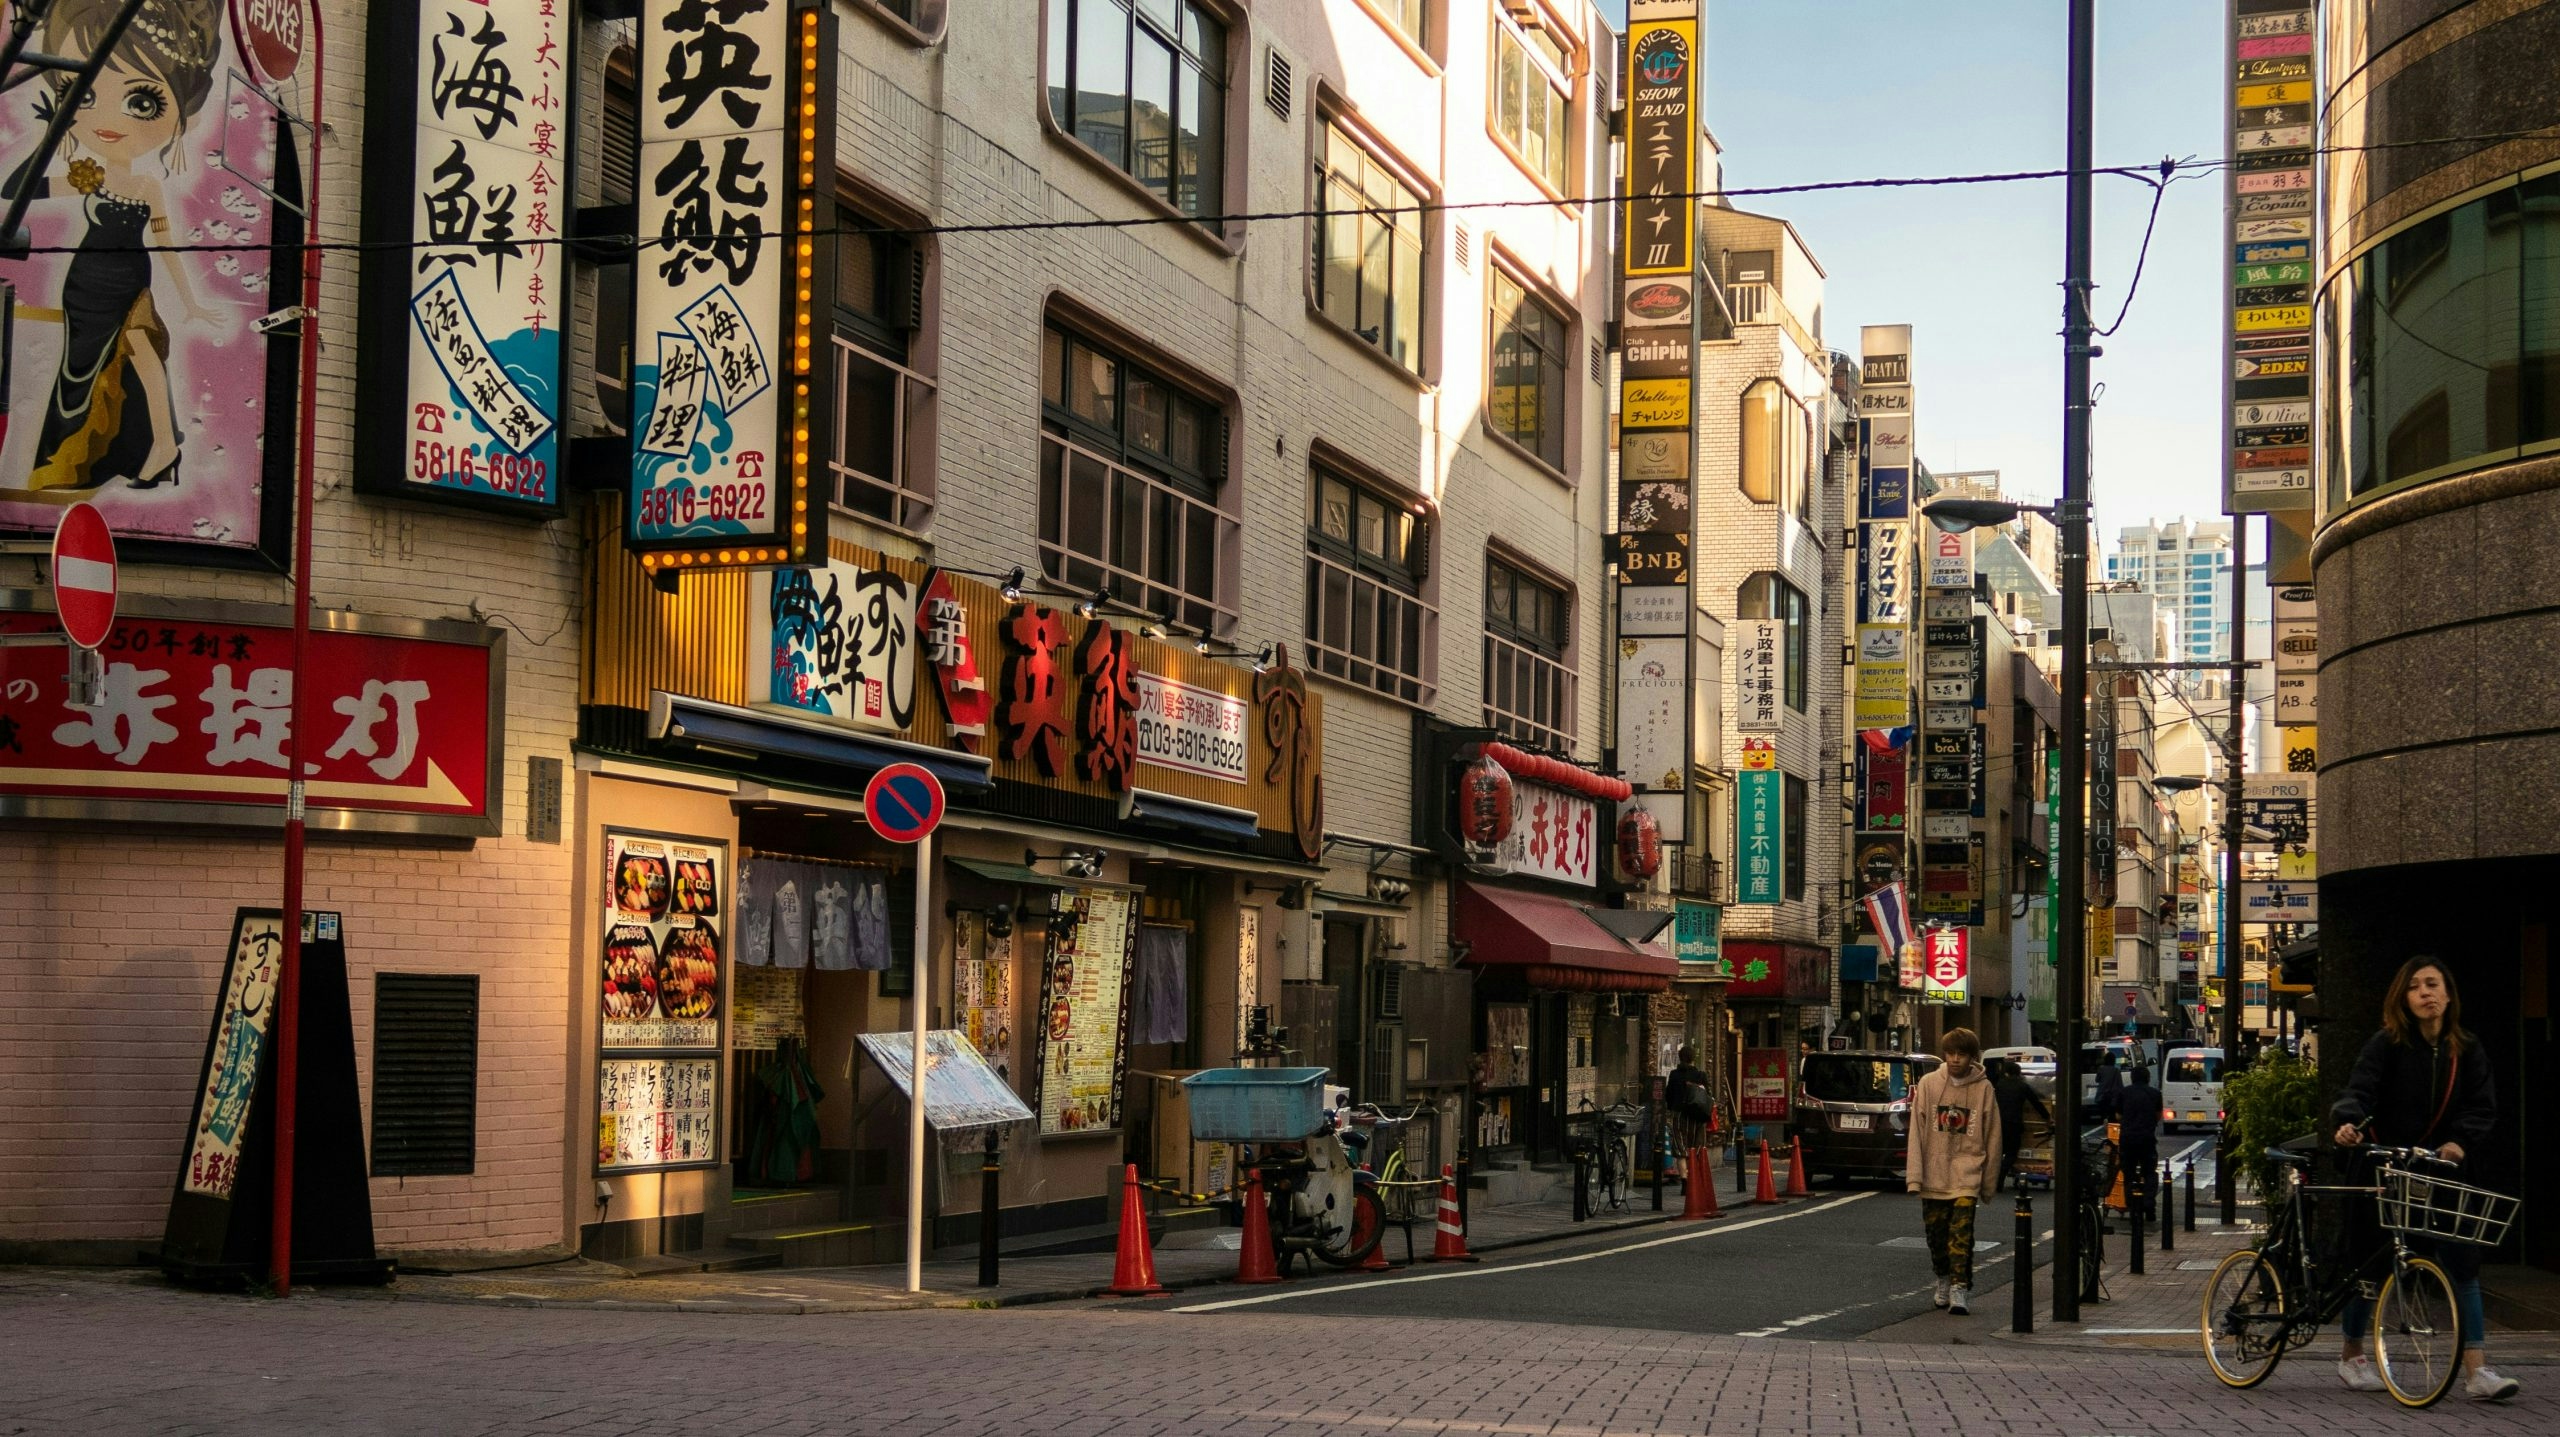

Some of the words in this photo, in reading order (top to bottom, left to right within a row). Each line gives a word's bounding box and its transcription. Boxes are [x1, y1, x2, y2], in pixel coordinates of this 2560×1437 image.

[1635, 86, 1684, 102] SHOW
[1639, 103, 1686, 118] BAND
[418, 10, 525, 293] 海鮮
[2246, 199, 2307, 212] Copain
[2247, 308, 2306, 323] わいわい
[695, 301, 762, 408] 海鮮
[1863, 361, 1906, 379] GRATIA
[2259, 360, 2308, 375] EDEN
[648, 344, 706, 449] 料理
[1630, 410, 1685, 423] チャレンジ
[1861, 394, 1908, 410] 信水ビル
[2266, 408, 2307, 423] Olive
[414, 439, 547, 498] 5816-6922
[640, 482, 766, 526] 5816-6922
[1628, 540, 1640, 549] 3F
[1876, 528, 1899, 617] クリスタル
[856, 551, 918, 730] すし
[928, 598, 986, 737] 第二
[1621, 680, 1685, 688] PRECIOUS
[1743, 647, 1754, 705] ダイモン
[1757, 623, 1774, 721] 行政書士事務所
[1143, 684, 1242, 736] 大小宴会予約承ります
[1153, 721, 1243, 772] 03-5816-6922
[1254, 641, 1324, 859] すし
[1935, 743, 1961, 753] brat
[2095, 681, 2112, 811] CENTURION
[1529, 795, 1593, 880] 赤提灯
[2095, 819, 2111, 897] HOTEL
[2267, 884, 2289, 892] BAR
[608, 1063, 618, 1111] シラウオ
